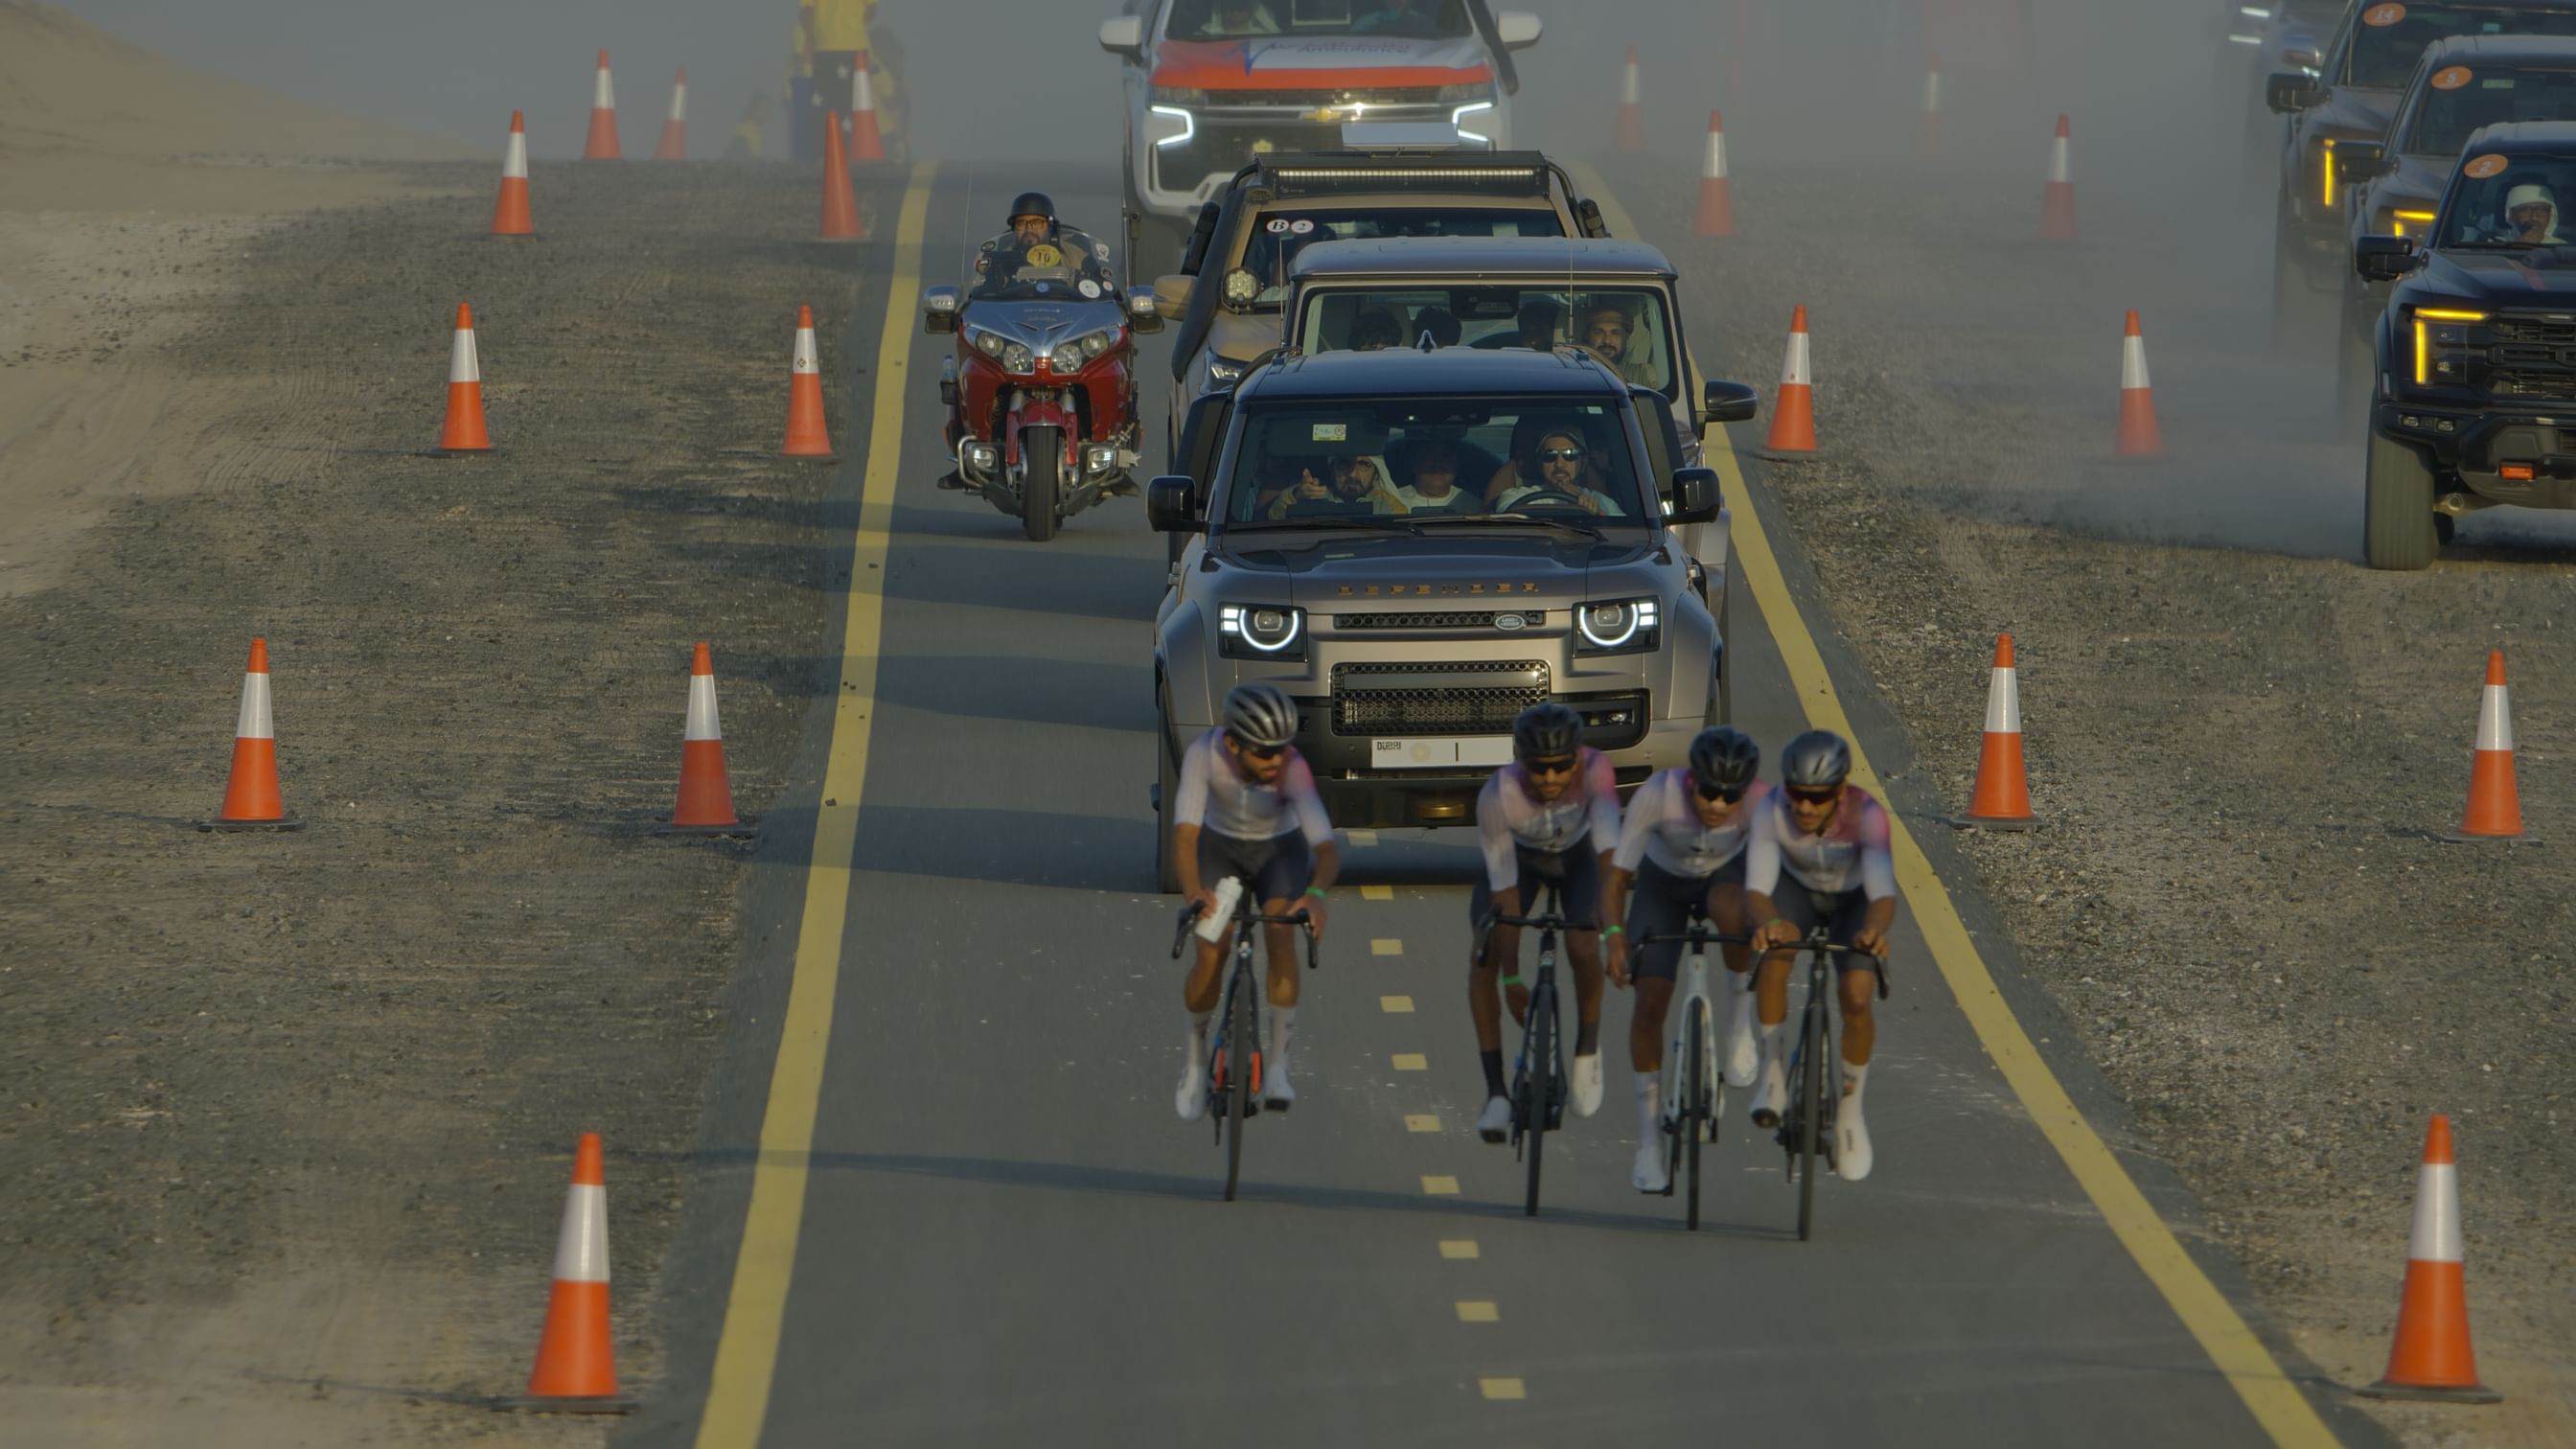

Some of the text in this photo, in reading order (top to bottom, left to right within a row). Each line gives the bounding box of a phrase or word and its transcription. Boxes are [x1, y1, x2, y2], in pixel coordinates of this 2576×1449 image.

[1273, 221, 1285, 230] B
[1338, 583, 1539, 595] DEFENDER
[1377, 741, 1401, 750] DUBAI
